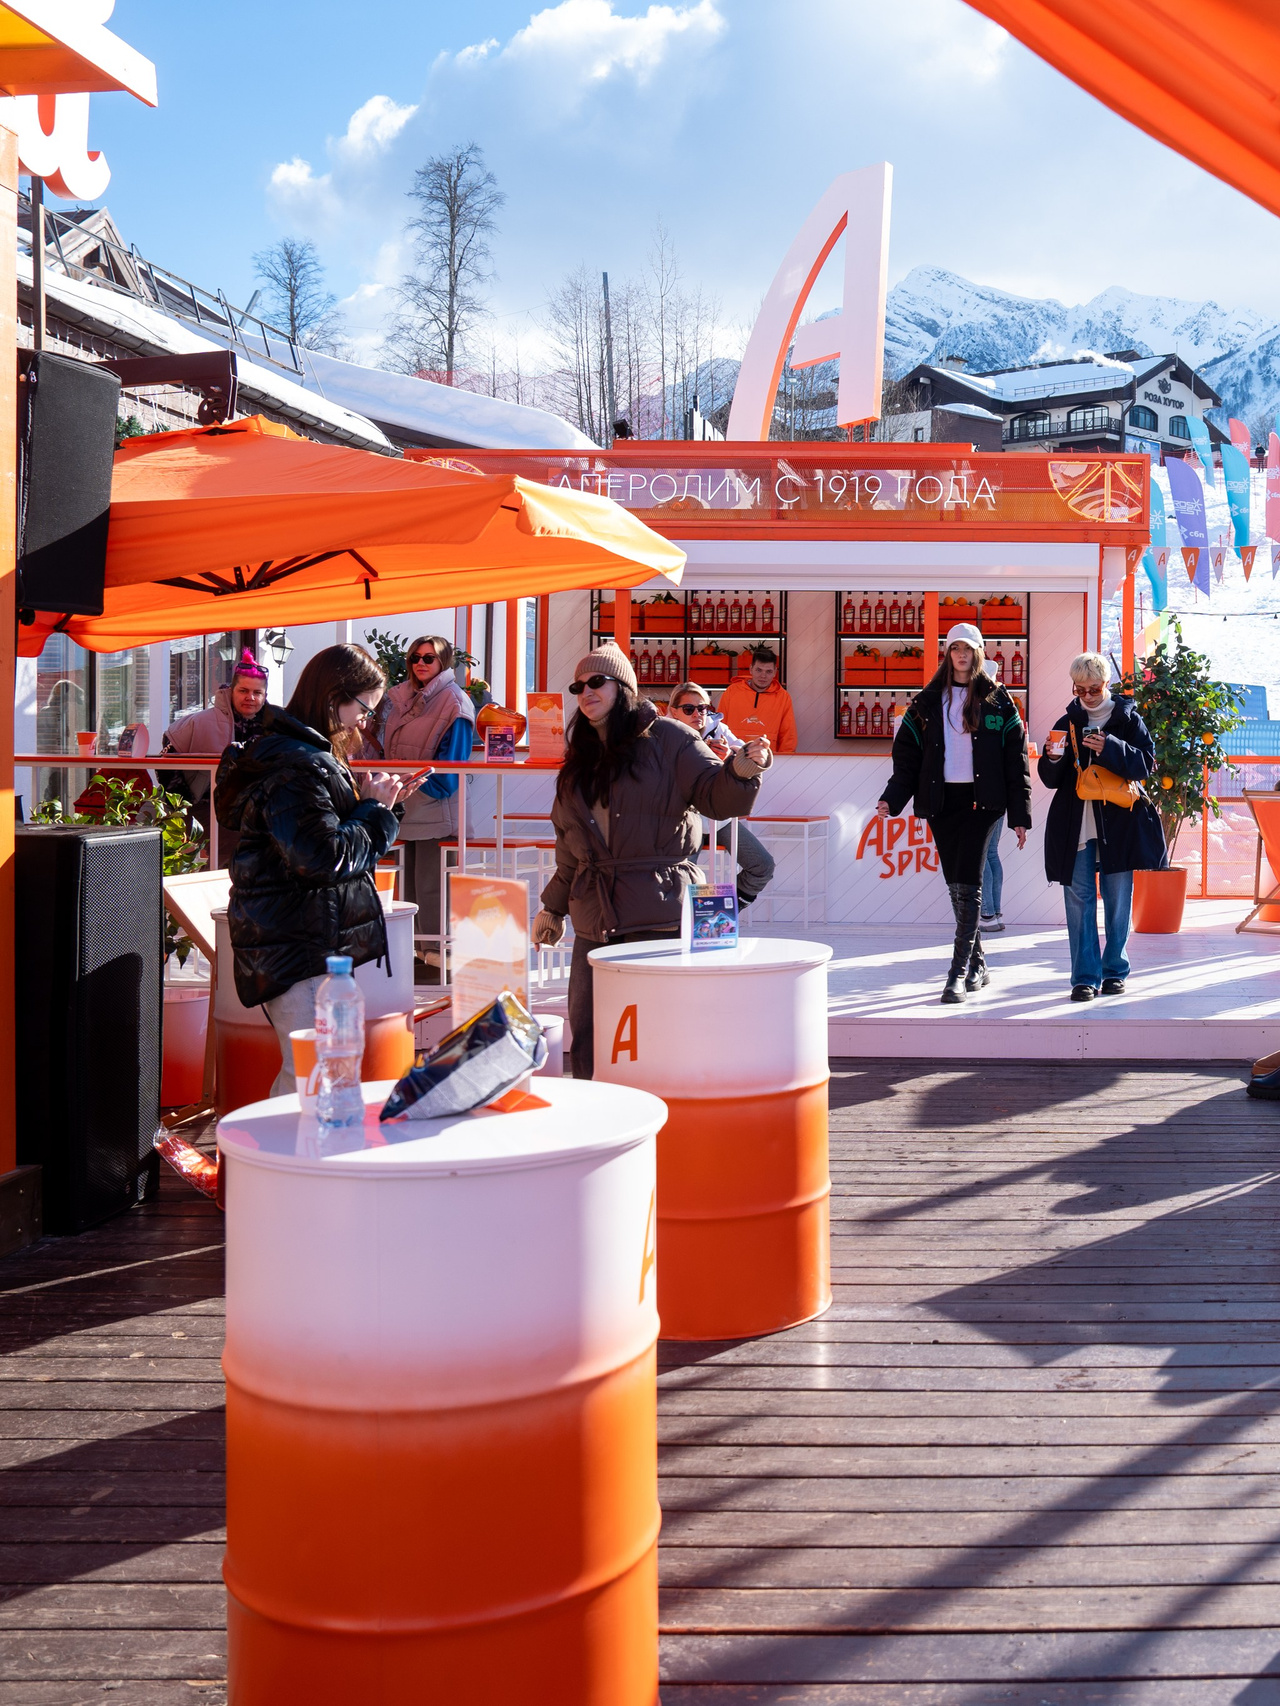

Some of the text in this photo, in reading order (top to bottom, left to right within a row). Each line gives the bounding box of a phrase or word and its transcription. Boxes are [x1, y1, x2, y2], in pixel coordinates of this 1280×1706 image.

[726, 161, 893, 441] A
[1144, 391, 1185, 410] РОЗА ХУТОР
[775, 475, 801, 503] С
[814, 475, 883, 504] 1919
[897, 475, 996, 509] ГОДА
[1189, 530, 1205, 539] сбп
[1158, 552, 1166, 565] A
[1187, 553, 1195, 567] A
[1215, 552, 1222, 567] A
[1244, 552, 1252, 566] A
[610, 1003, 639, 1064] A
